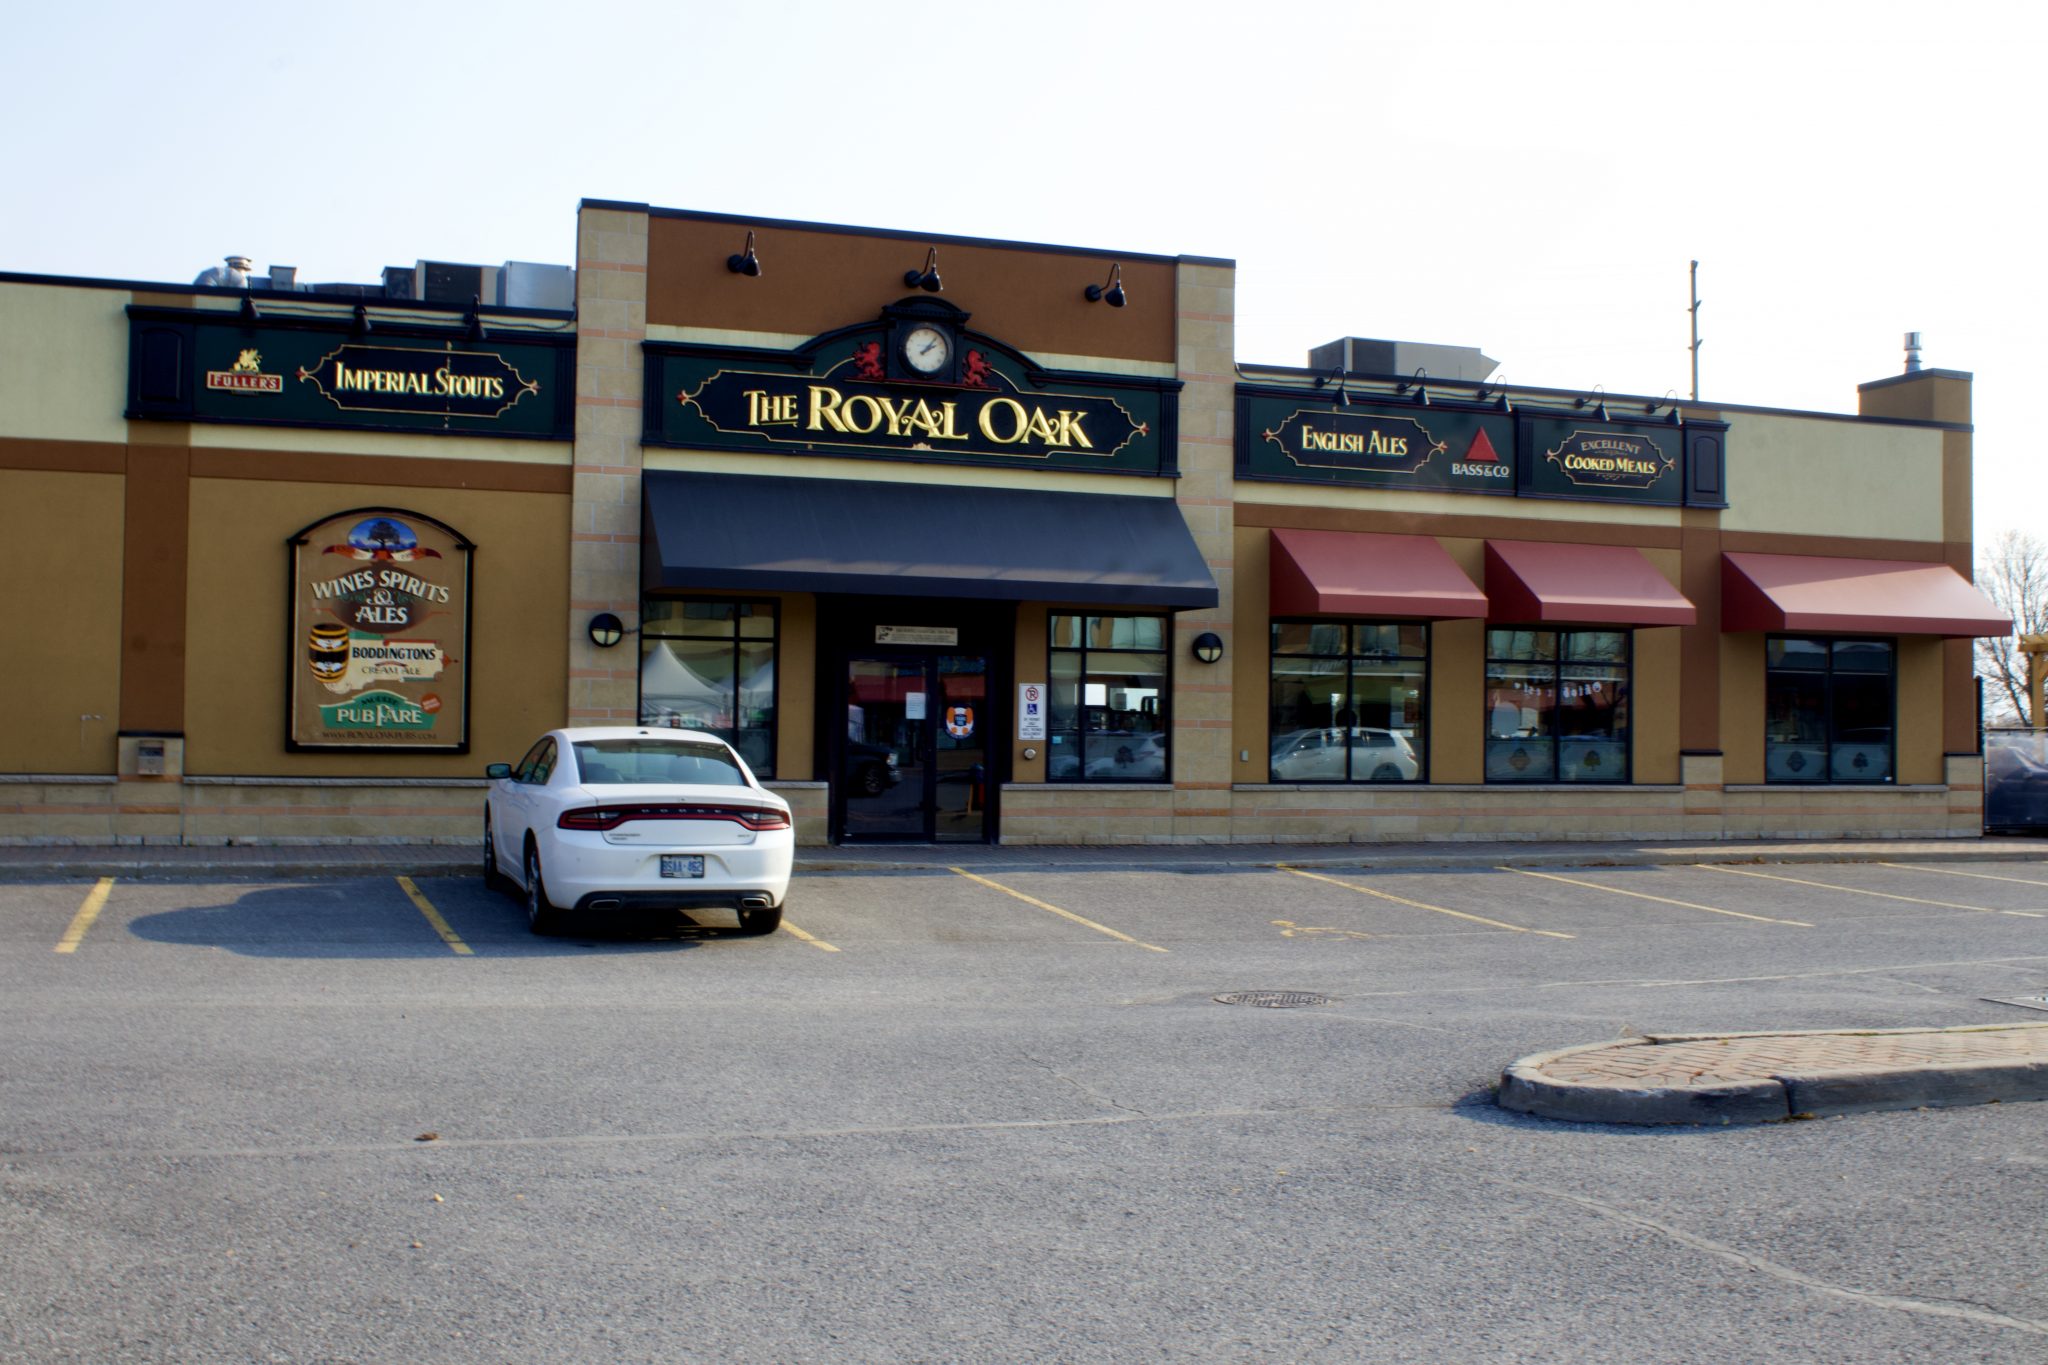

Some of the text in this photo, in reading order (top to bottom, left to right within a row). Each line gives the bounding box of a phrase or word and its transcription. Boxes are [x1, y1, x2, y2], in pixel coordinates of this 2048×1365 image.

[335, 361, 504, 398] IMPERIAL STOUTS
[743, 385, 1093, 448] THE ROYAL OAK
[1302, 425, 1408, 456] ENGLISH ALES
[1580, 440, 1641, 455] EXCELLENT
[1564, 454, 1656, 475] COOKED MEALS
[311, 570, 449, 604] WINES SPIRITS
[366, 588, 394, 606] &
[355, 606, 408, 624] ALES
[352, 647, 436, 660] BODDINGTONS
